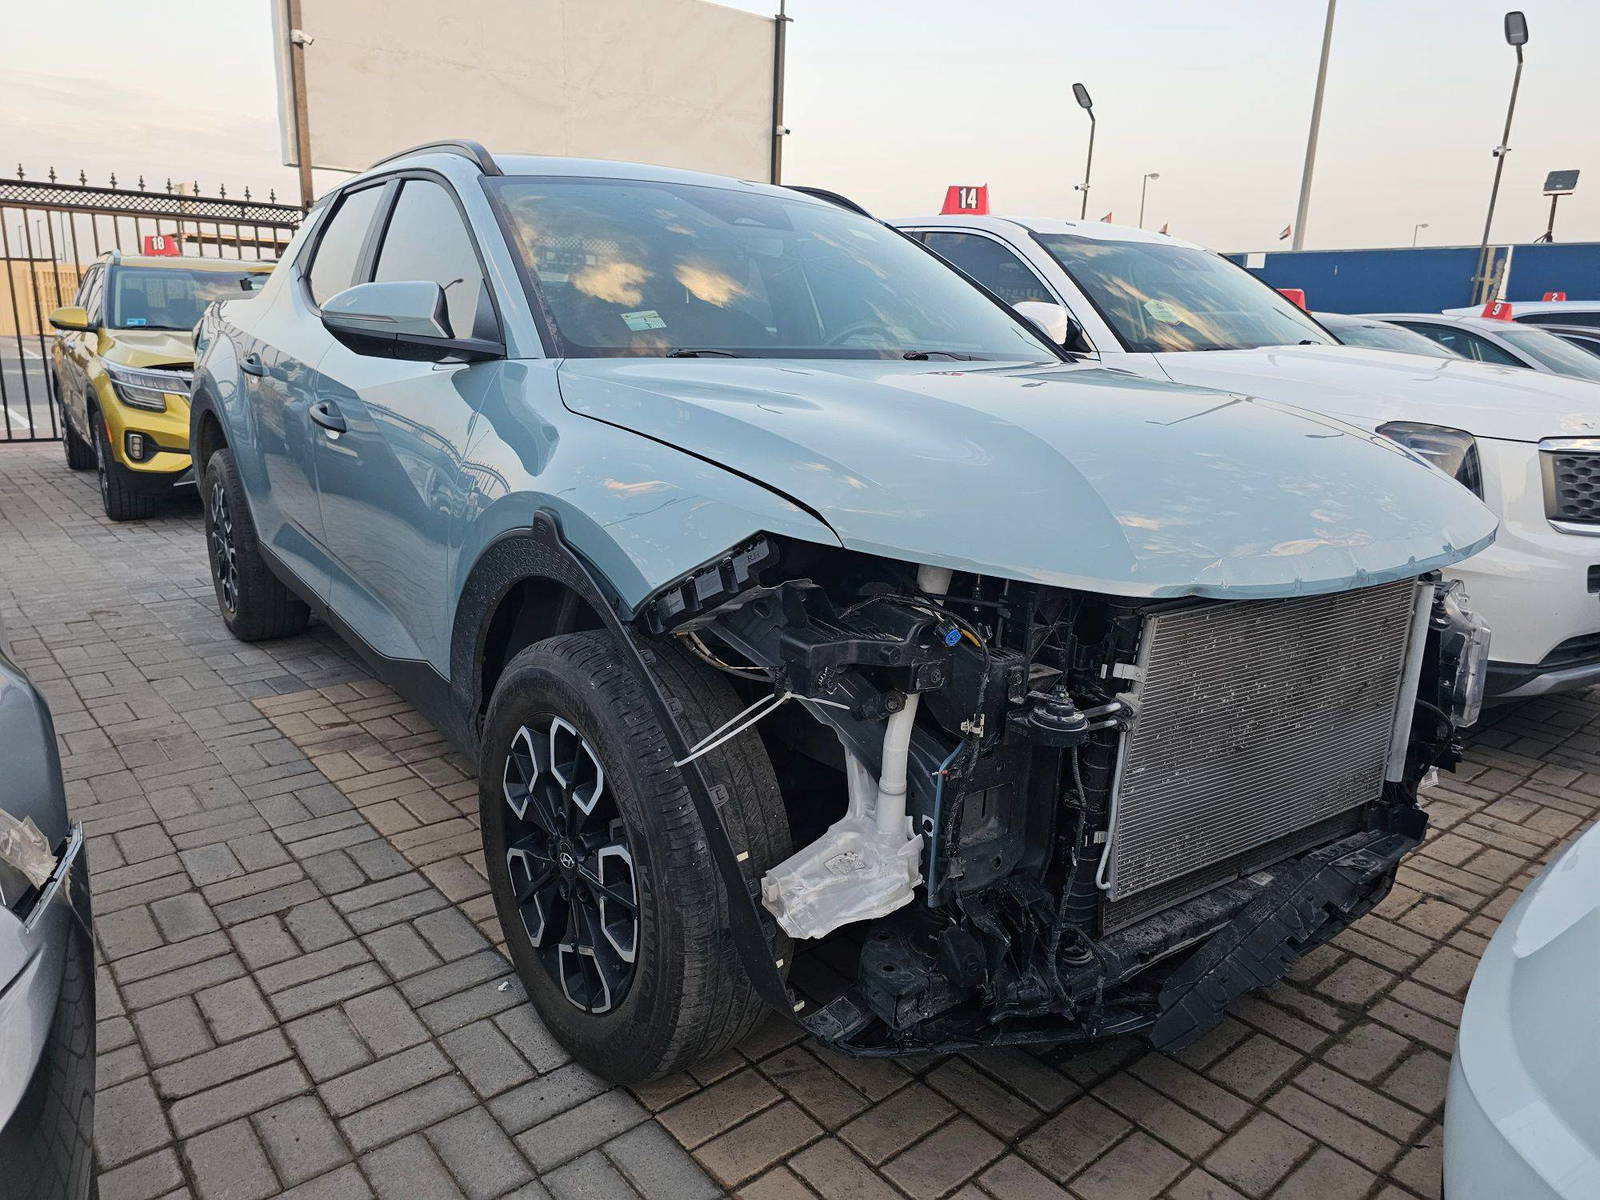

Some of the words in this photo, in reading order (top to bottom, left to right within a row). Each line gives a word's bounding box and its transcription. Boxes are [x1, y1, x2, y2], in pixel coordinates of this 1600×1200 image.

[960, 187, 977, 209] 14
[152, 236, 165, 250] 18
[1551, 292, 1558, 302] 2
[1492, 303, 1502, 316] 9
